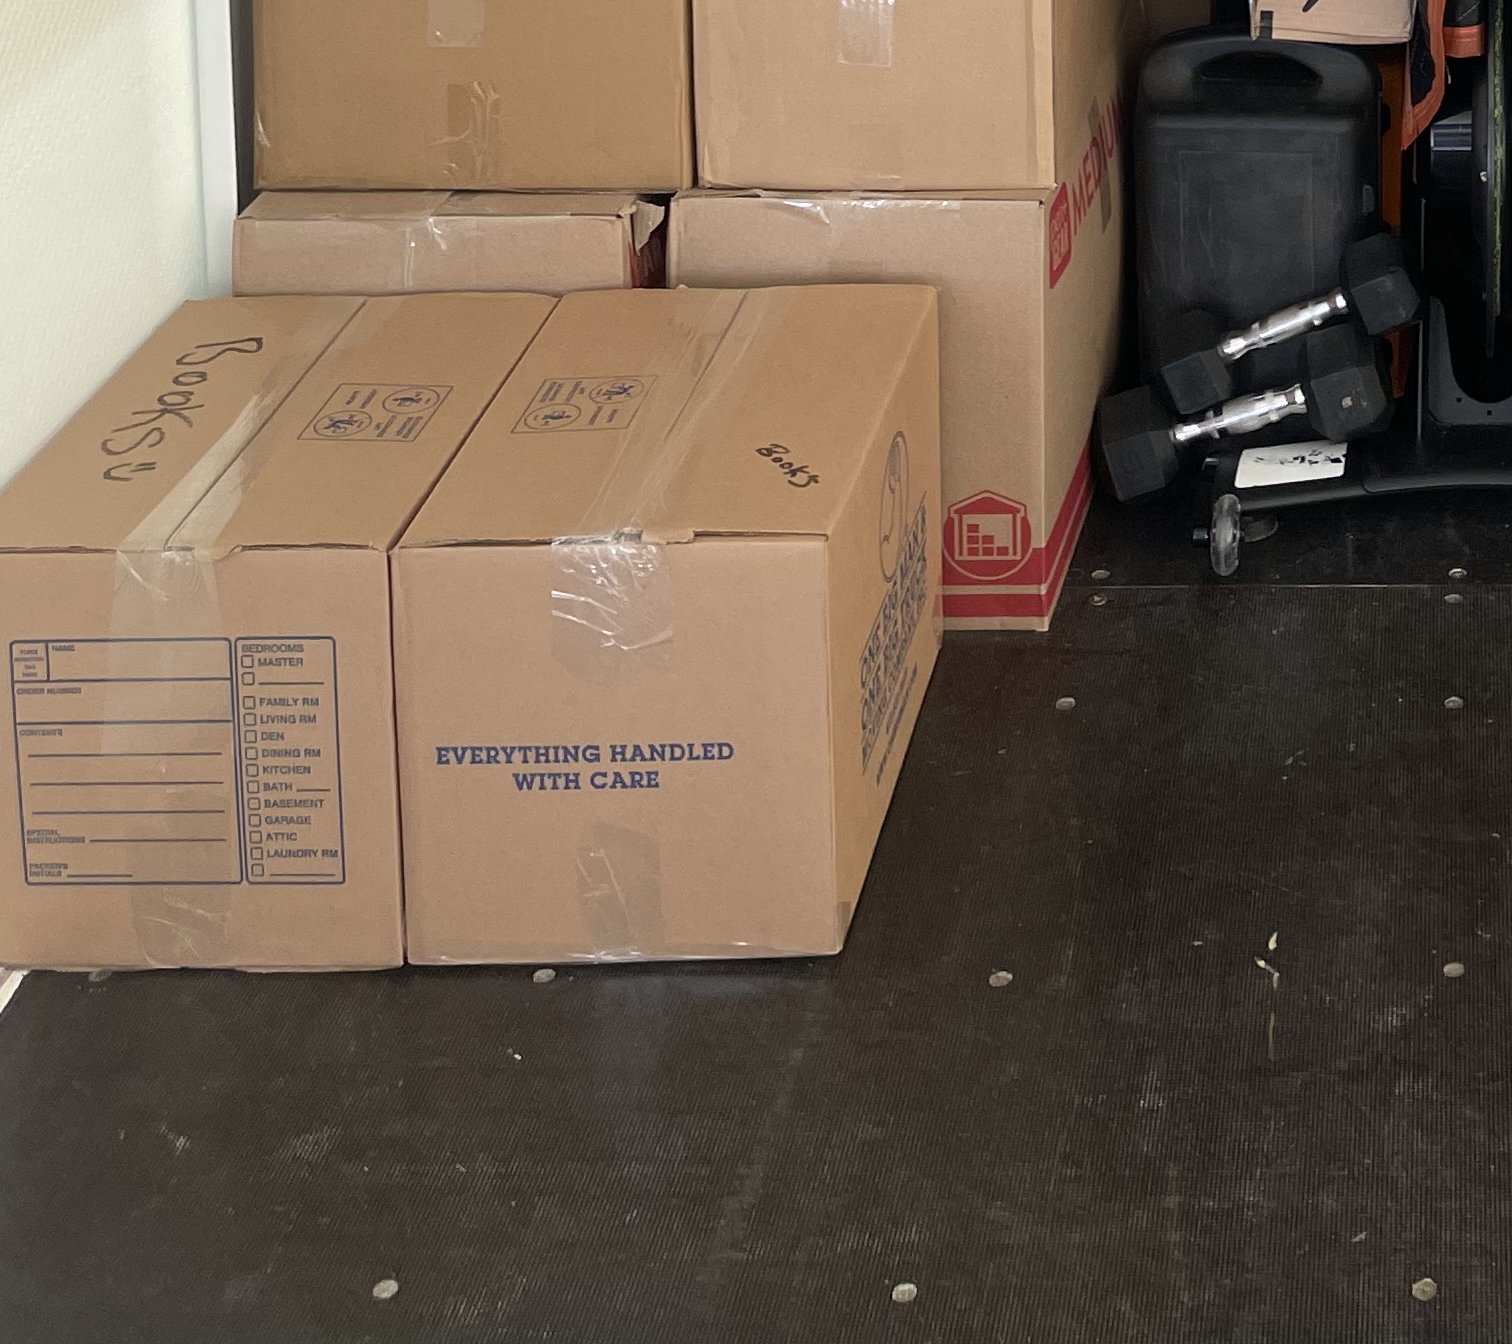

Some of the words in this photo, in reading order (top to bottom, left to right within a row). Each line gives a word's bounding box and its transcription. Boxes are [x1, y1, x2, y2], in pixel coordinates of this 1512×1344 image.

[51, 644, 76, 652] NAME
[241, 643, 305, 654] BEDROOMS
[257, 657, 304, 667] MASTER
[16, 687, 45, 695] ORDER
[46, 687, 82, 695] NUMBER
[259, 697, 300, 707] FAMILY
[302, 697, 320, 707] RM
[260, 715, 297, 725] LIVING
[299, 715, 317, 724] RM
[19, 728, 63, 737] CONTENTS
[260, 731, 285, 741] DEN
[261, 748, 301, 758] DINING
[303, 748, 321, 758] RM
[435, 744, 601, 765] EVERYTHING
[609, 741, 735, 763] HANDLED
[262, 765, 312, 775] KITCHEN
[512, 771, 583, 791] WITH
[590, 771, 660, 790] CARE
[262, 782, 293, 792] BATH
[263, 799, 325, 809] BASEMENT
[264, 815, 312, 825] GARAGE
[265, 832, 298, 841] ATTIC
[266, 848, 319, 859] LAUNDRY
[321, 849, 339, 858] RM
